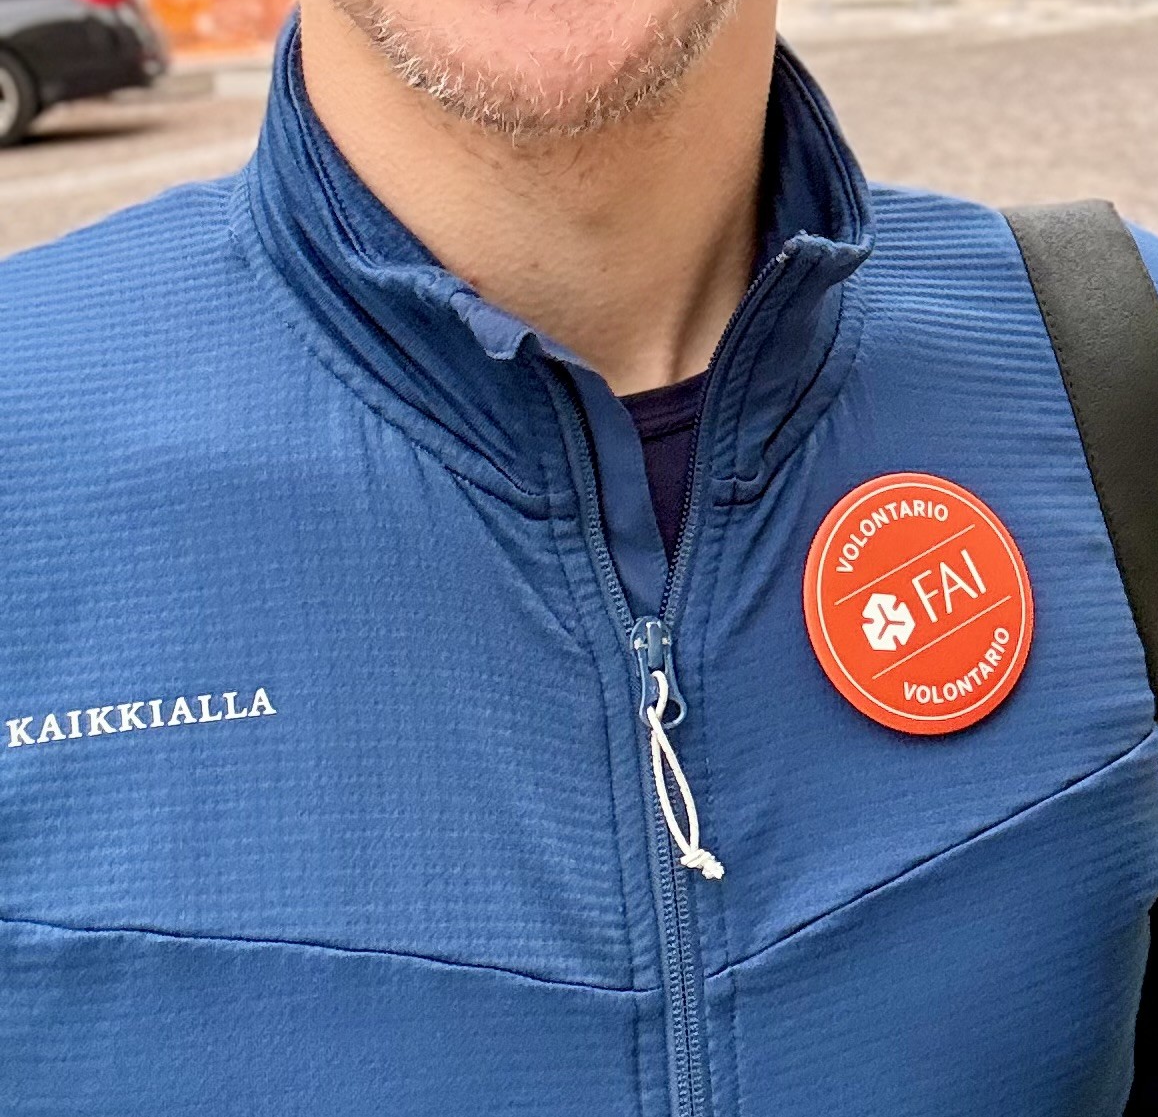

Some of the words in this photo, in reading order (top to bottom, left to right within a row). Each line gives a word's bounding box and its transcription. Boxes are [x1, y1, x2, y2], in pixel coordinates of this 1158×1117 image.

[836, 499, 949, 574] VOLONTARIO
[911, 548, 987, 624] FAI
[903, 626, 1010, 705] VOLONTARIO
[5, 687, 277, 748] KAIKKIALLA
